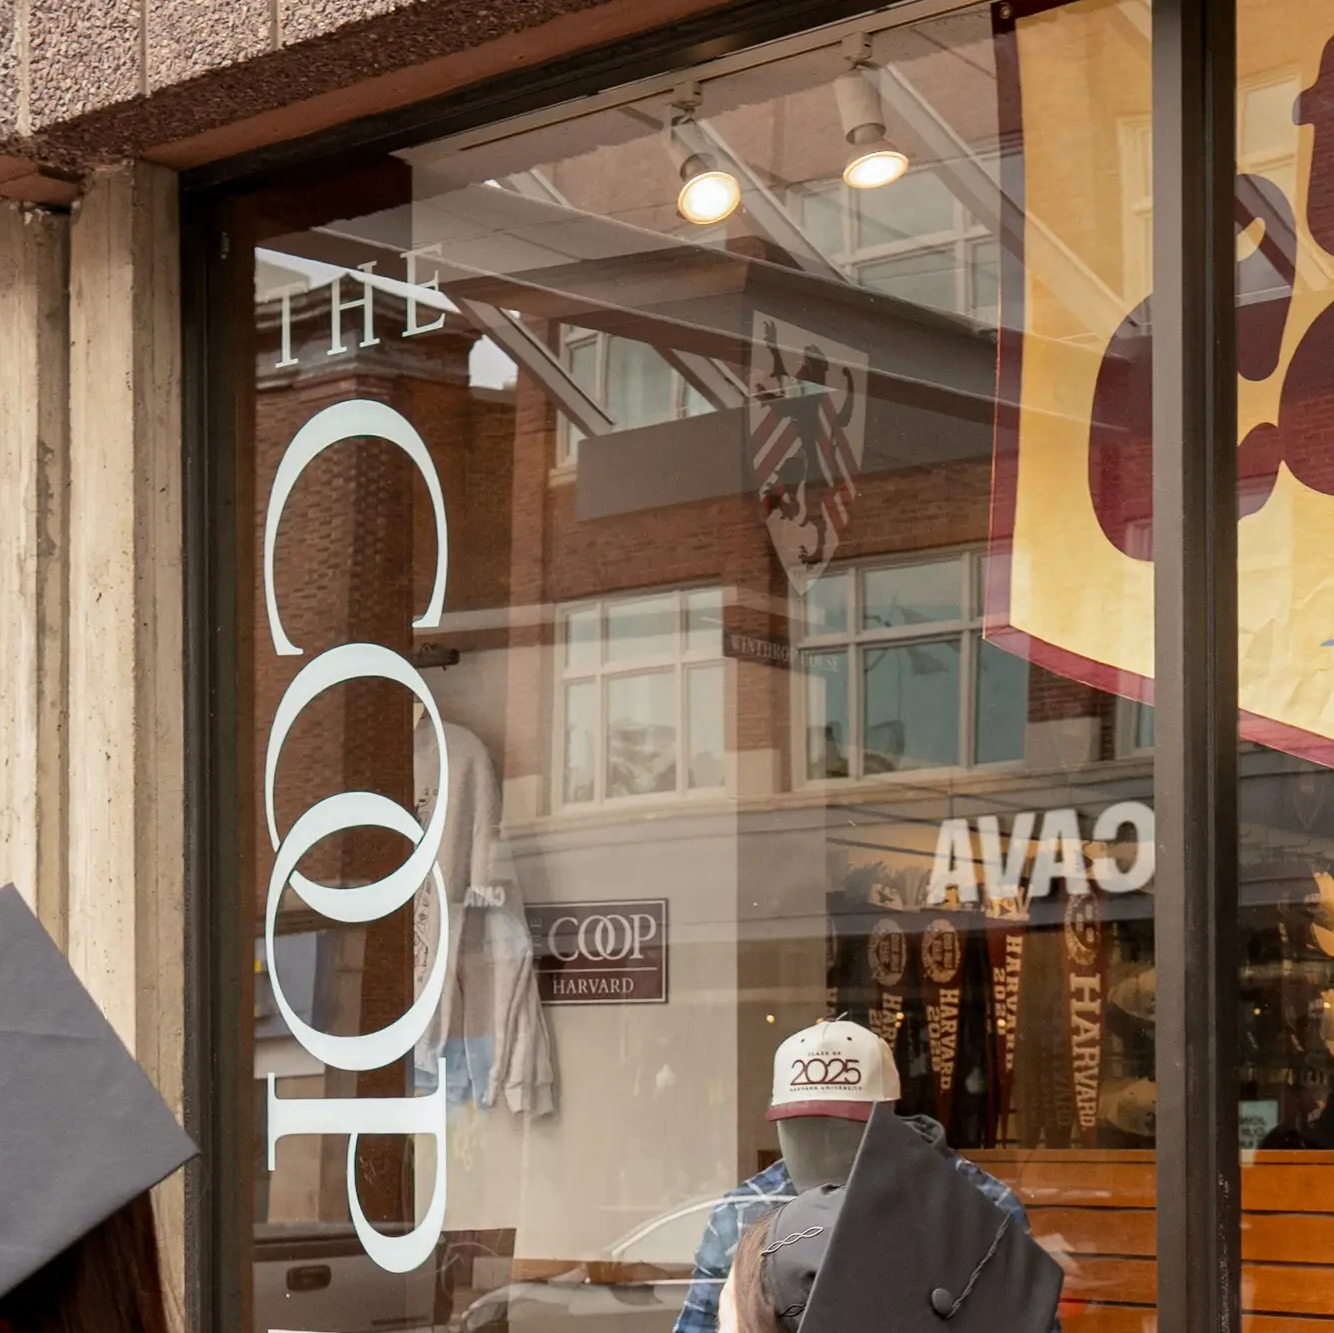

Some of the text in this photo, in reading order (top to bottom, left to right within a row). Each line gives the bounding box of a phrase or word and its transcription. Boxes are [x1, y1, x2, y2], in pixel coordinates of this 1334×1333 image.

[272, 243, 451, 370] THE
[264, 399, 451, 1274] COOP
[547, 913, 658, 963] COOP
[551, 976, 636, 995] HARVARD
[939, 988, 960, 1090] HARVARD
[1005, 935, 1023, 1070] HARVARD
[1070, 972, 1101, 1128] HARVARD
[790, 1058, 862, 1086] 2025
